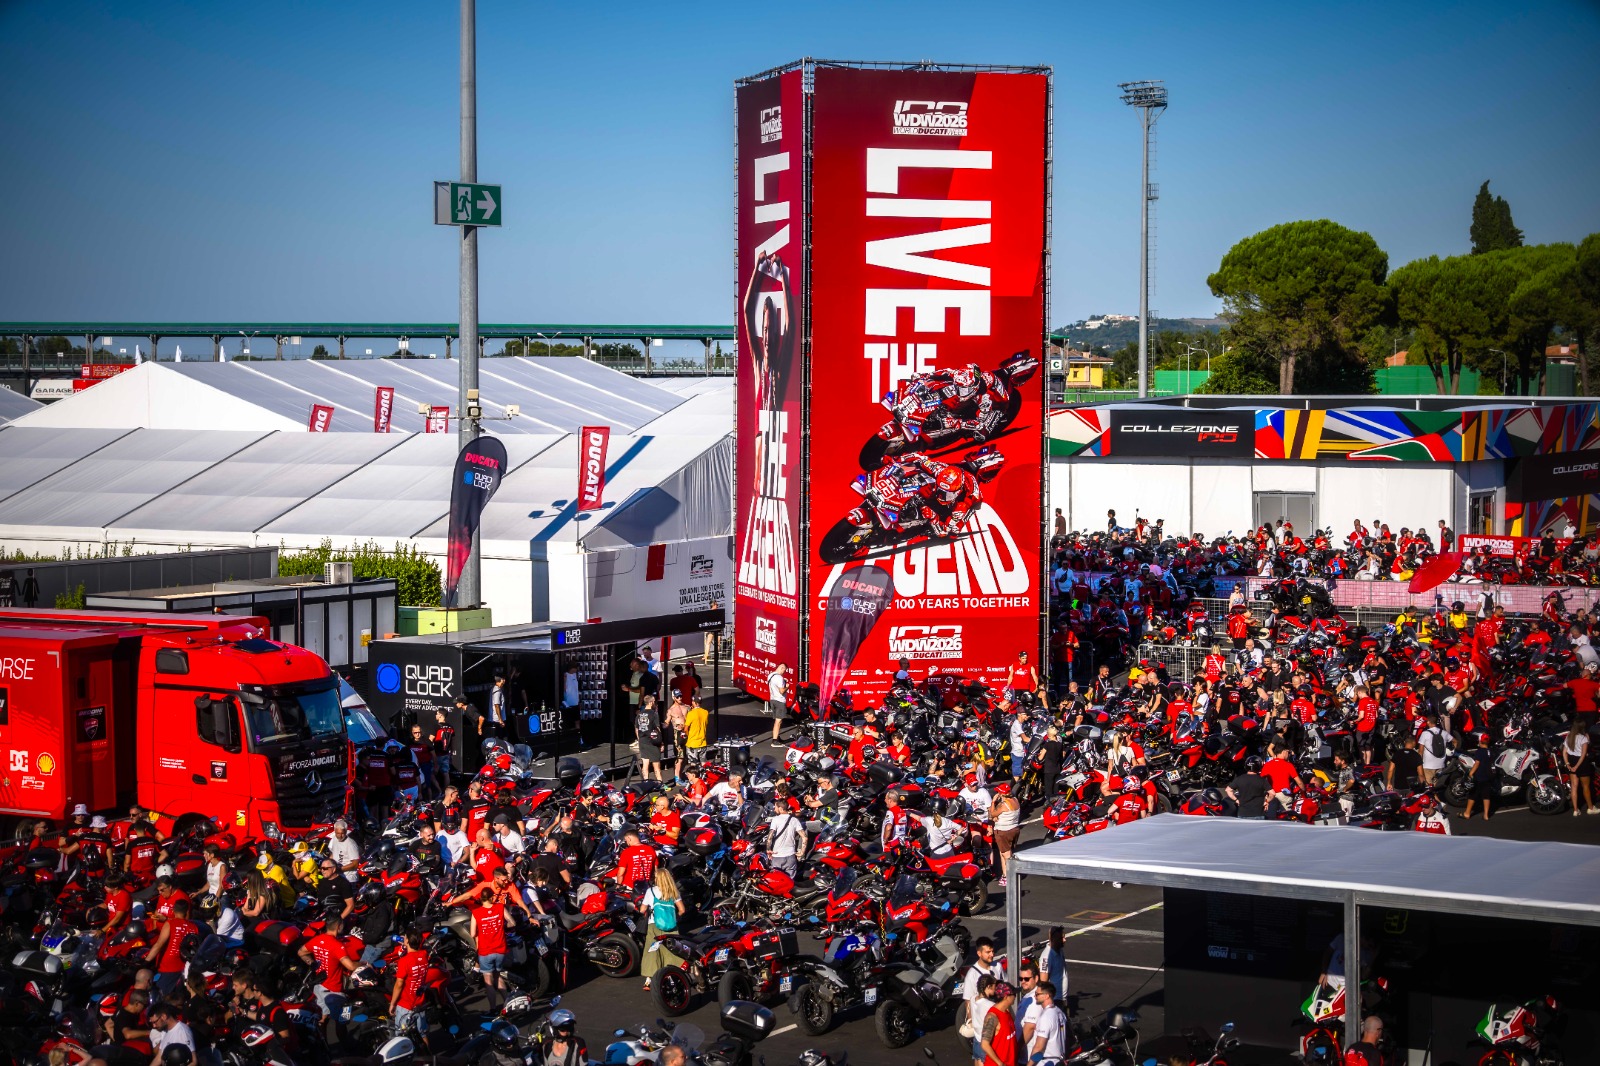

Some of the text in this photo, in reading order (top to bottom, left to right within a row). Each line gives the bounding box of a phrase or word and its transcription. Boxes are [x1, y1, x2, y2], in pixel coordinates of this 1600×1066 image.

[893, 112, 968, 128] WDW2026
[864, 147, 993, 337] LIVE
[1053, 361, 1060, 369] C
[864, 343, 938, 404] THE
[1120, 425, 1240, 433] COLLEZIONE
[464, 452, 499, 470] DUCATI
[758, 410, 788, 499] THE
[583, 431, 603, 502] DUCATI
[1552, 462, 1600, 475] COLLEZIONE
[473, 480, 492, 491] LOCK
[474, 472, 493, 483] QUAD
[738, 497, 797, 596] LEGEND
[841, 579, 885, 597] DUCATI
[679, 590, 726, 606] UNA LEGGENDA
[853, 598, 877, 610] QUAD
[895, 599, 915, 610] 100
[918, 598, 959, 610] YEARS
[962, 597, 1030, 609] TOGETHER
[852, 606, 876, 617] LOCK
[565, 635, 582, 644] LOCK
[889, 637, 963, 652] WDW2026
[0, 657, 35, 681] RSE
[405, 664, 453, 682] QUAD
[405, 680, 453, 698] LOCK
